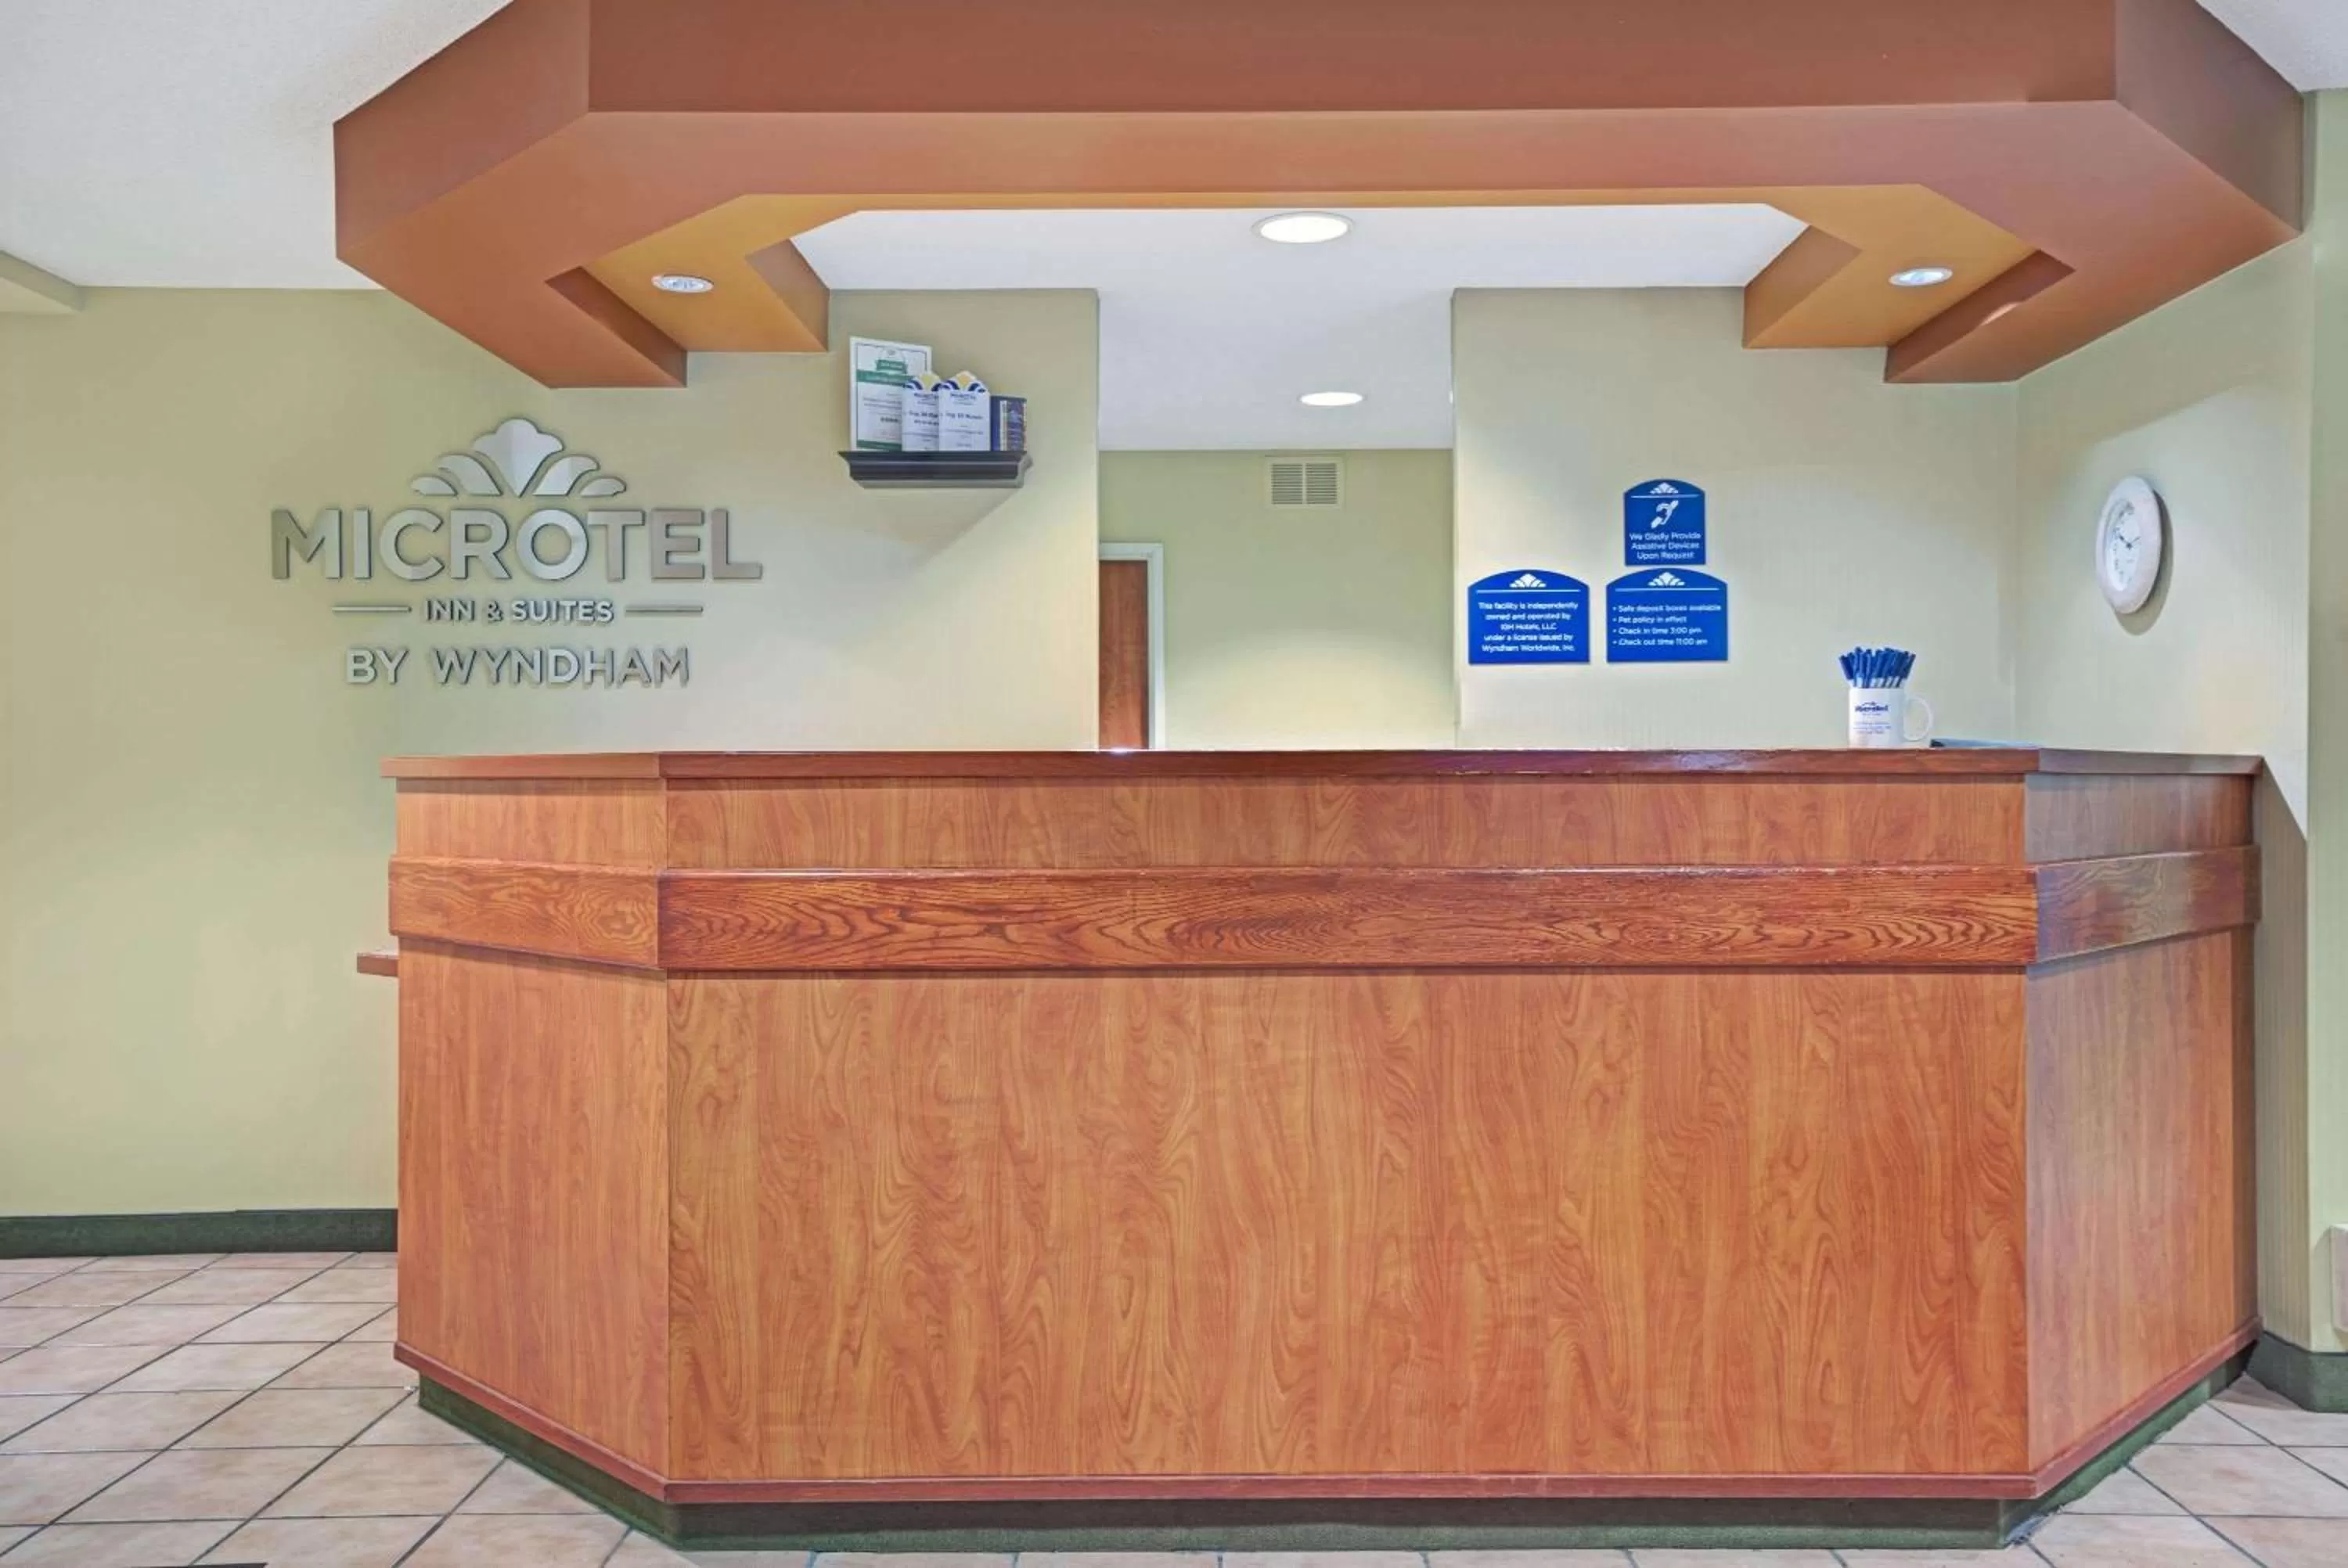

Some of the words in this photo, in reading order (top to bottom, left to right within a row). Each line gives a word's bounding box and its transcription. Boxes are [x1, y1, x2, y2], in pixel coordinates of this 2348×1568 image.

[1644, 532, 1669, 541] Gladly
[270, 507, 764, 581] MICROTEL
[1637, 551, 1659, 560] Upon
[1660, 551, 1695, 560] Request
[1494, 601, 1518, 610] facility
[1527, 601, 1579, 610] independently
[1618, 604, 1634, 613] Safe
[1636, 604, 1664, 613] deposit
[1689, 603, 1722, 612] available
[425, 599, 476, 623] INN
[486, 600, 505, 623] &
[511, 599, 615, 624] SUITES
[1527, 613, 1560, 621] operated
[1561, 612, 1572, 620] by
[1632, 616, 1655, 624] policy
[1665, 615, 1687, 624] effect
[1542, 622, 1558, 631] LLC
[1669, 626, 1688, 635] 3:00
[1513, 633, 1538, 642] license
[1539, 633, 1562, 642] issued
[1564, 633, 1574, 642] by
[1482, 644, 1519, 653] Wyndham
[345, 648, 410, 685] BY
[432, 647, 690, 688] WYNDHAM
